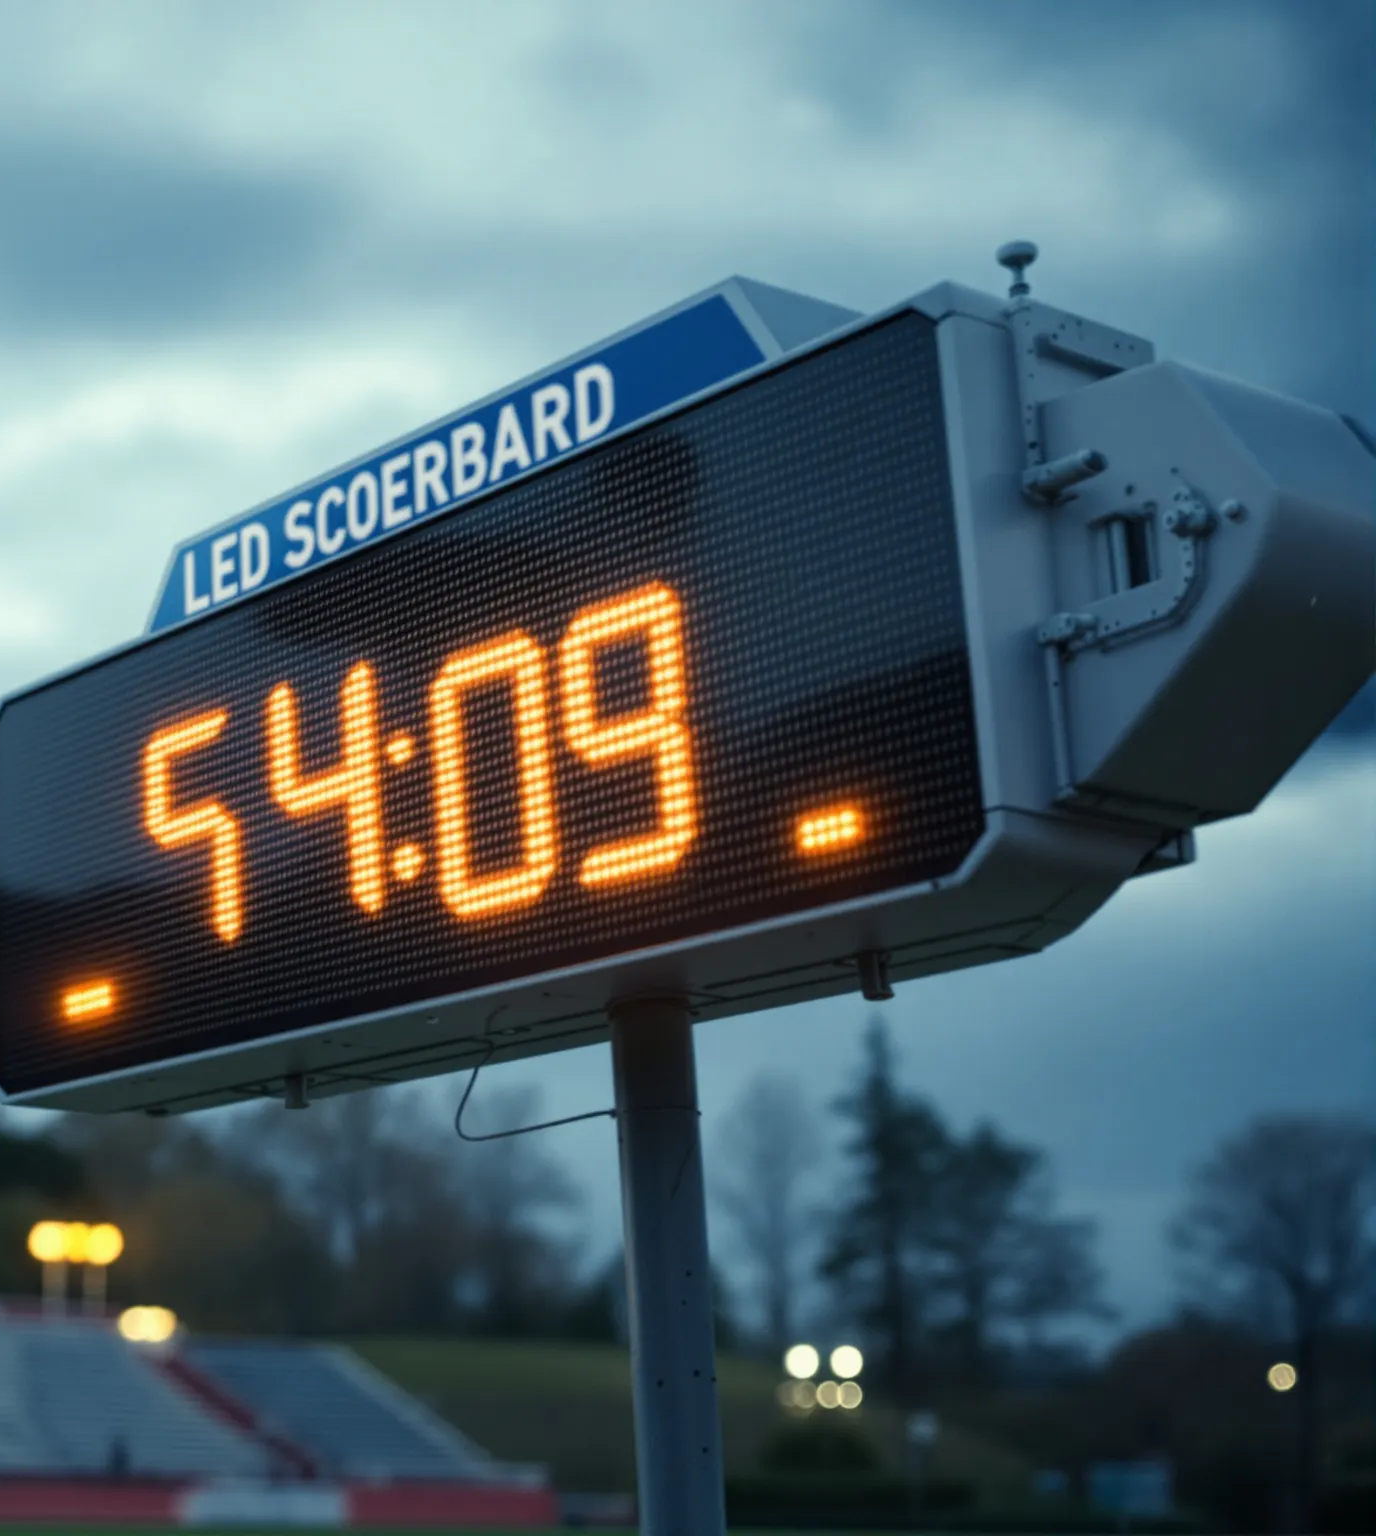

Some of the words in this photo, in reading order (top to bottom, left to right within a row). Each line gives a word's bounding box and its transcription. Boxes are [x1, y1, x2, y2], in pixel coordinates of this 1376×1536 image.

[182, 521, 270, 616] LED
[284, 364, 615, 568] SCOERBARD
[141, 581, 698, 942] 54:09
